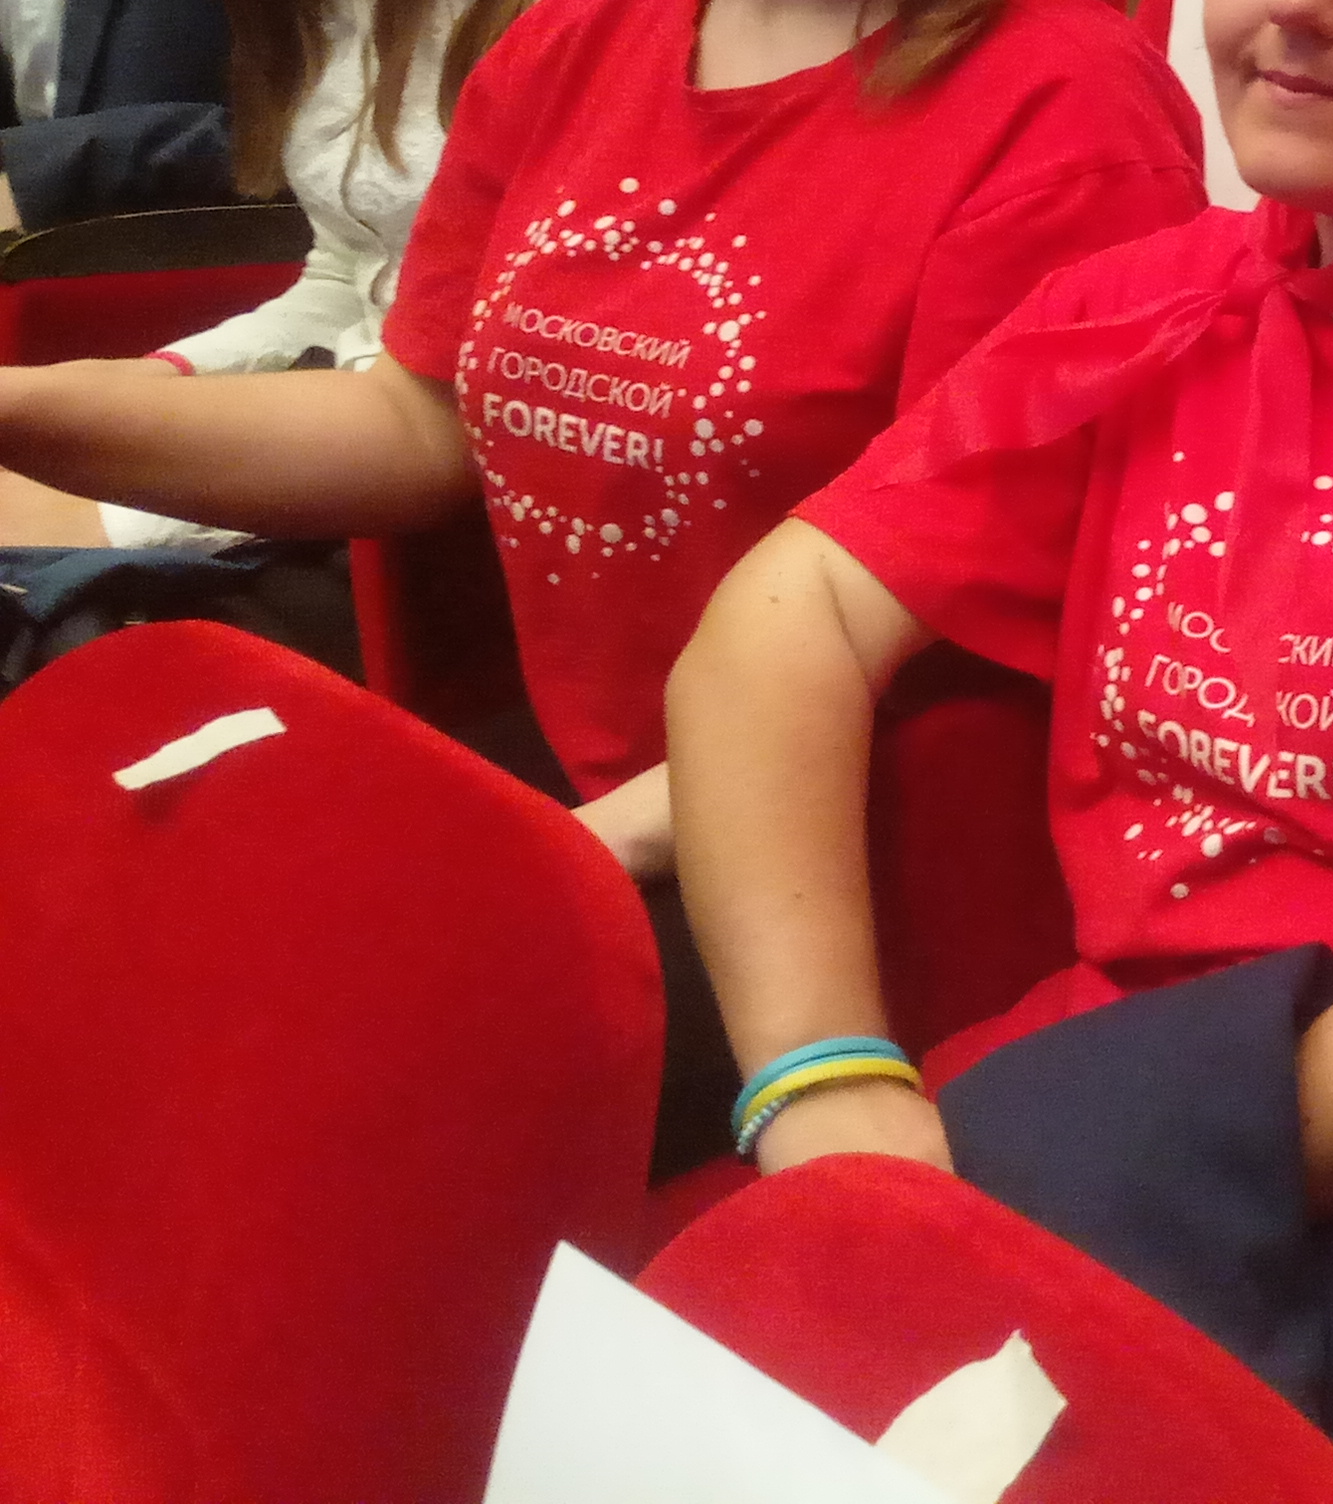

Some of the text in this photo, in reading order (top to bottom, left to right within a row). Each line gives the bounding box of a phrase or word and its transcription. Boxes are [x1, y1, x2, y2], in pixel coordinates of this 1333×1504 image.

[504, 302, 692, 369] МОСКОВСКИЙ
[486, 347, 674, 419] ГОРОДСКОЙ
[482, 392, 665, 474] FOREVER!
